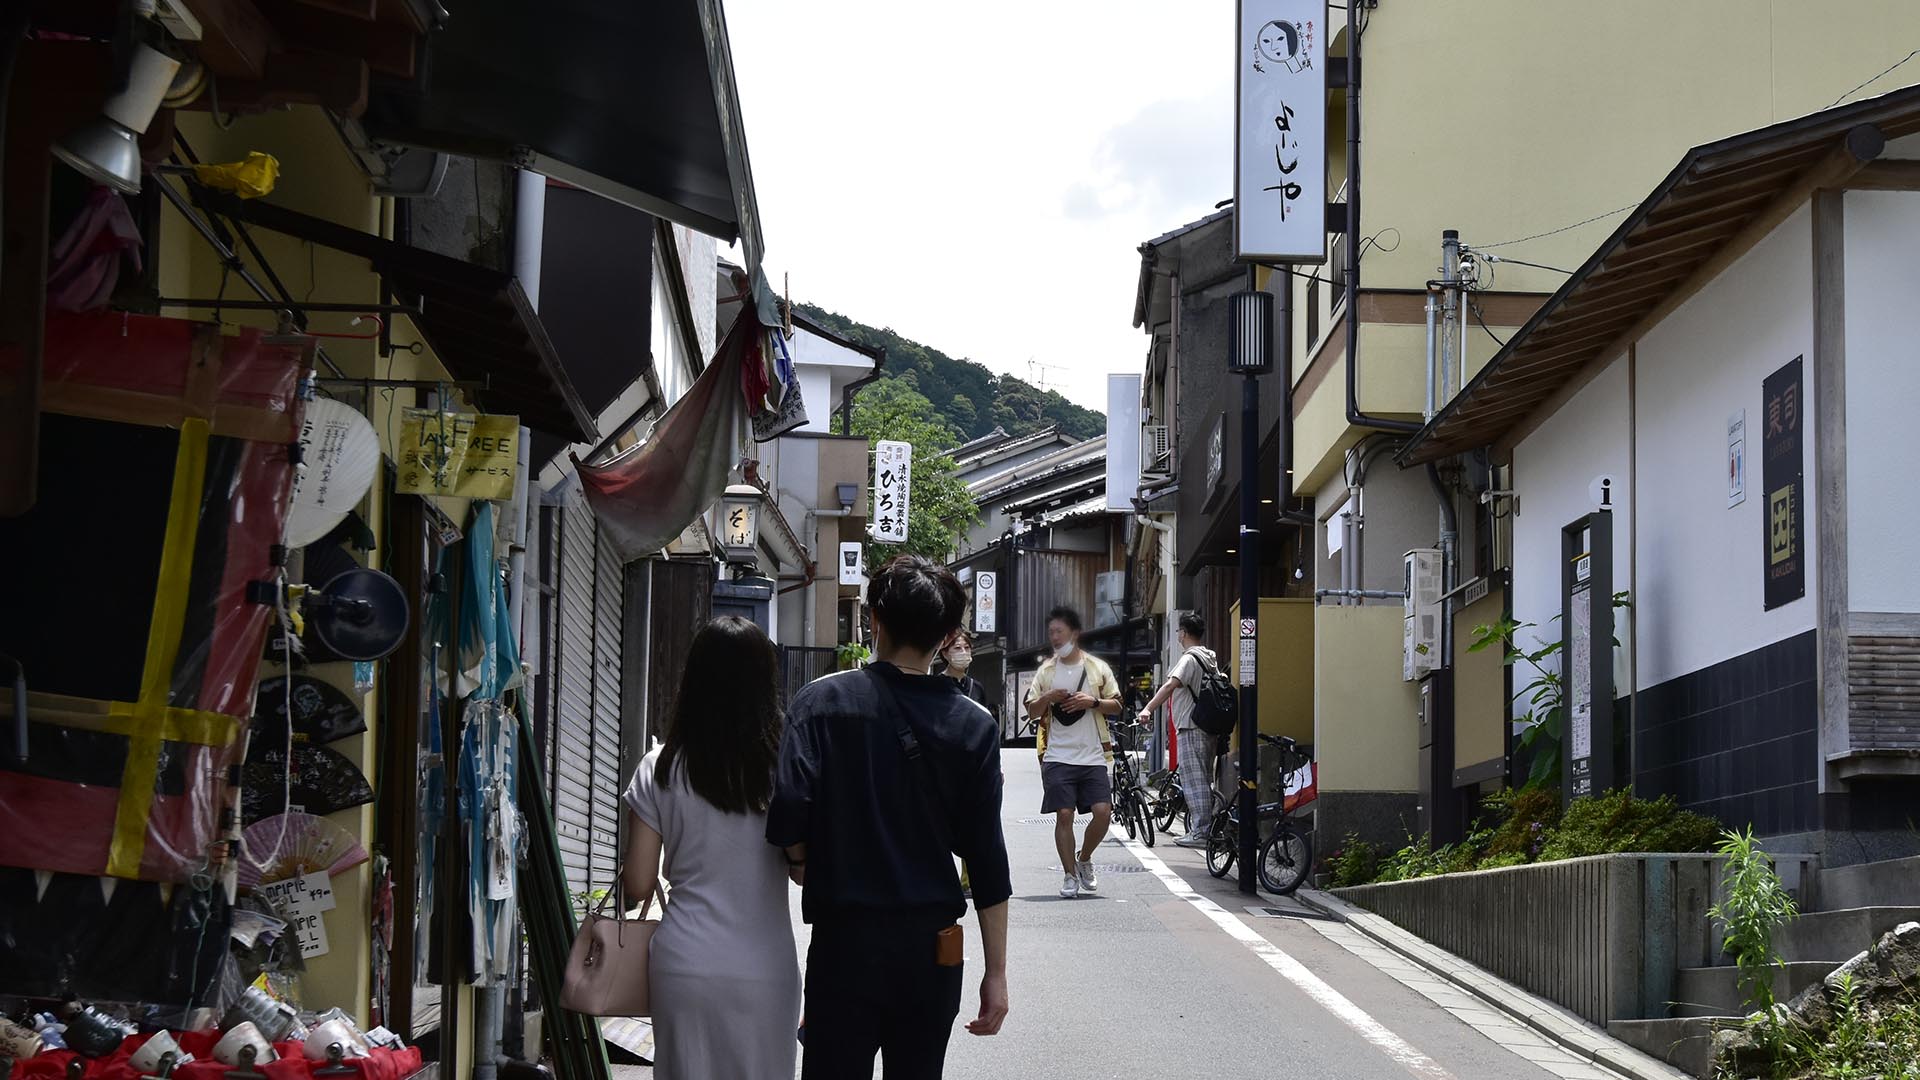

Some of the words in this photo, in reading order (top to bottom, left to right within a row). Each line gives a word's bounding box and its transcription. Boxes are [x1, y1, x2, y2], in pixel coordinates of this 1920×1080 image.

[1263, 100, 1302, 223] よーじや
[451, 419, 511, 453] FREE
[879, 469, 896, 533] ひろ吉
[729, 508, 751, 545] そば
